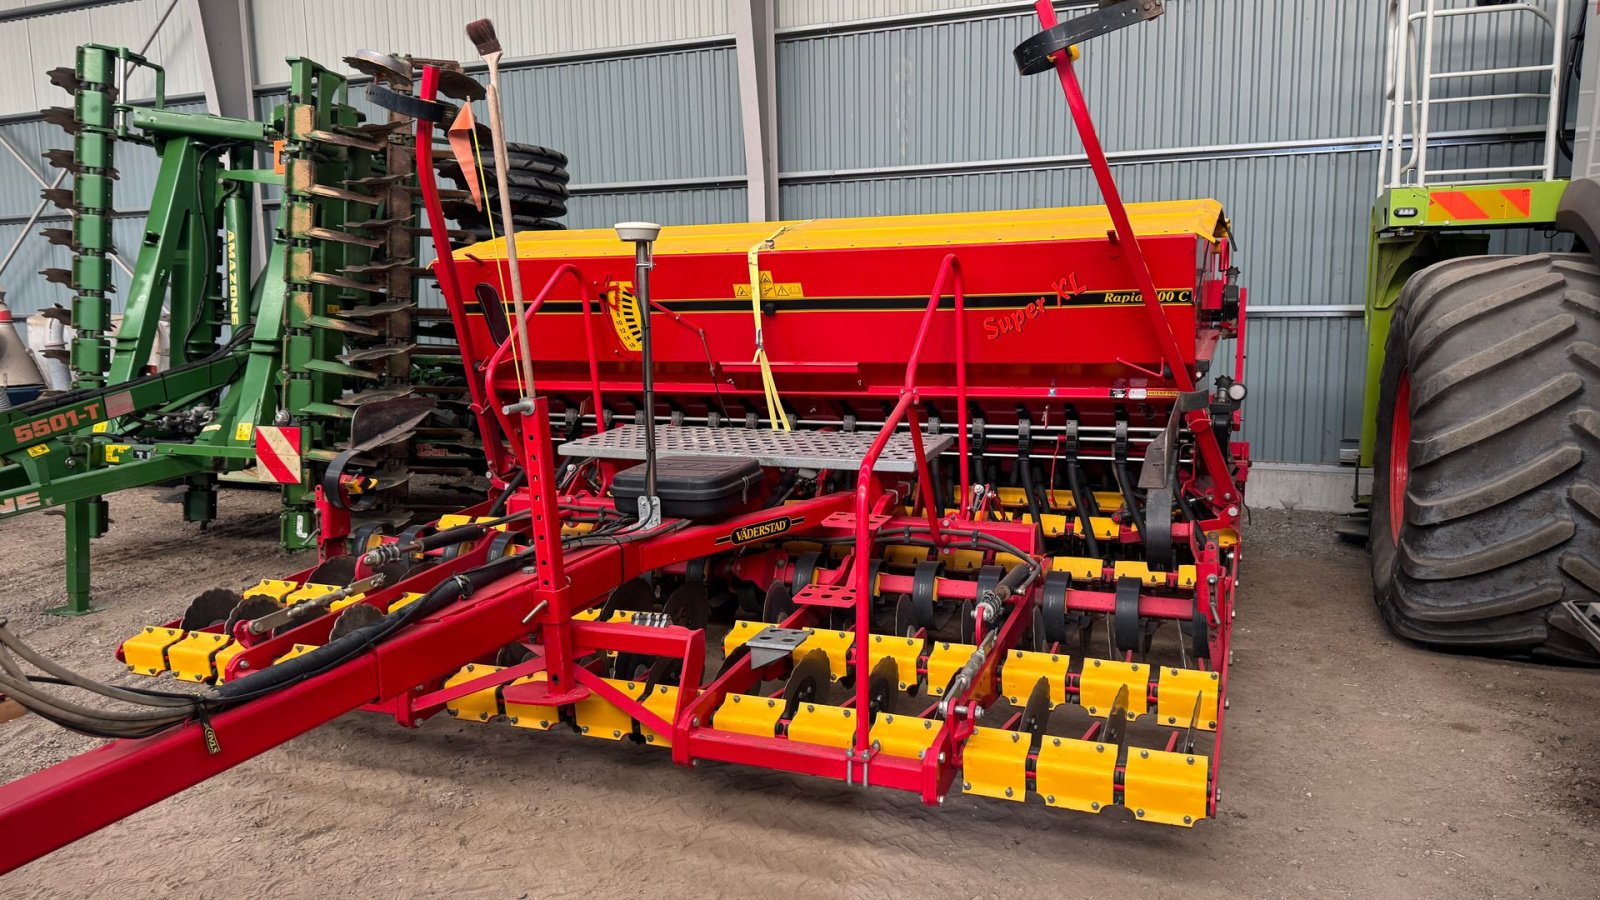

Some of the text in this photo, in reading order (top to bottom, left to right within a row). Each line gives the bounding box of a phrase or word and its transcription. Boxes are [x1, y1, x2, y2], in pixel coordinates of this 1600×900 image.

[227, 229, 239, 325] AMAZONE
[1178, 290, 1190, 302] C
[983, 271, 1088, 340] Super XL
[13, 403, 100, 443] 5501-T
[736, 520, 787, 541] VÄDERSTAD
